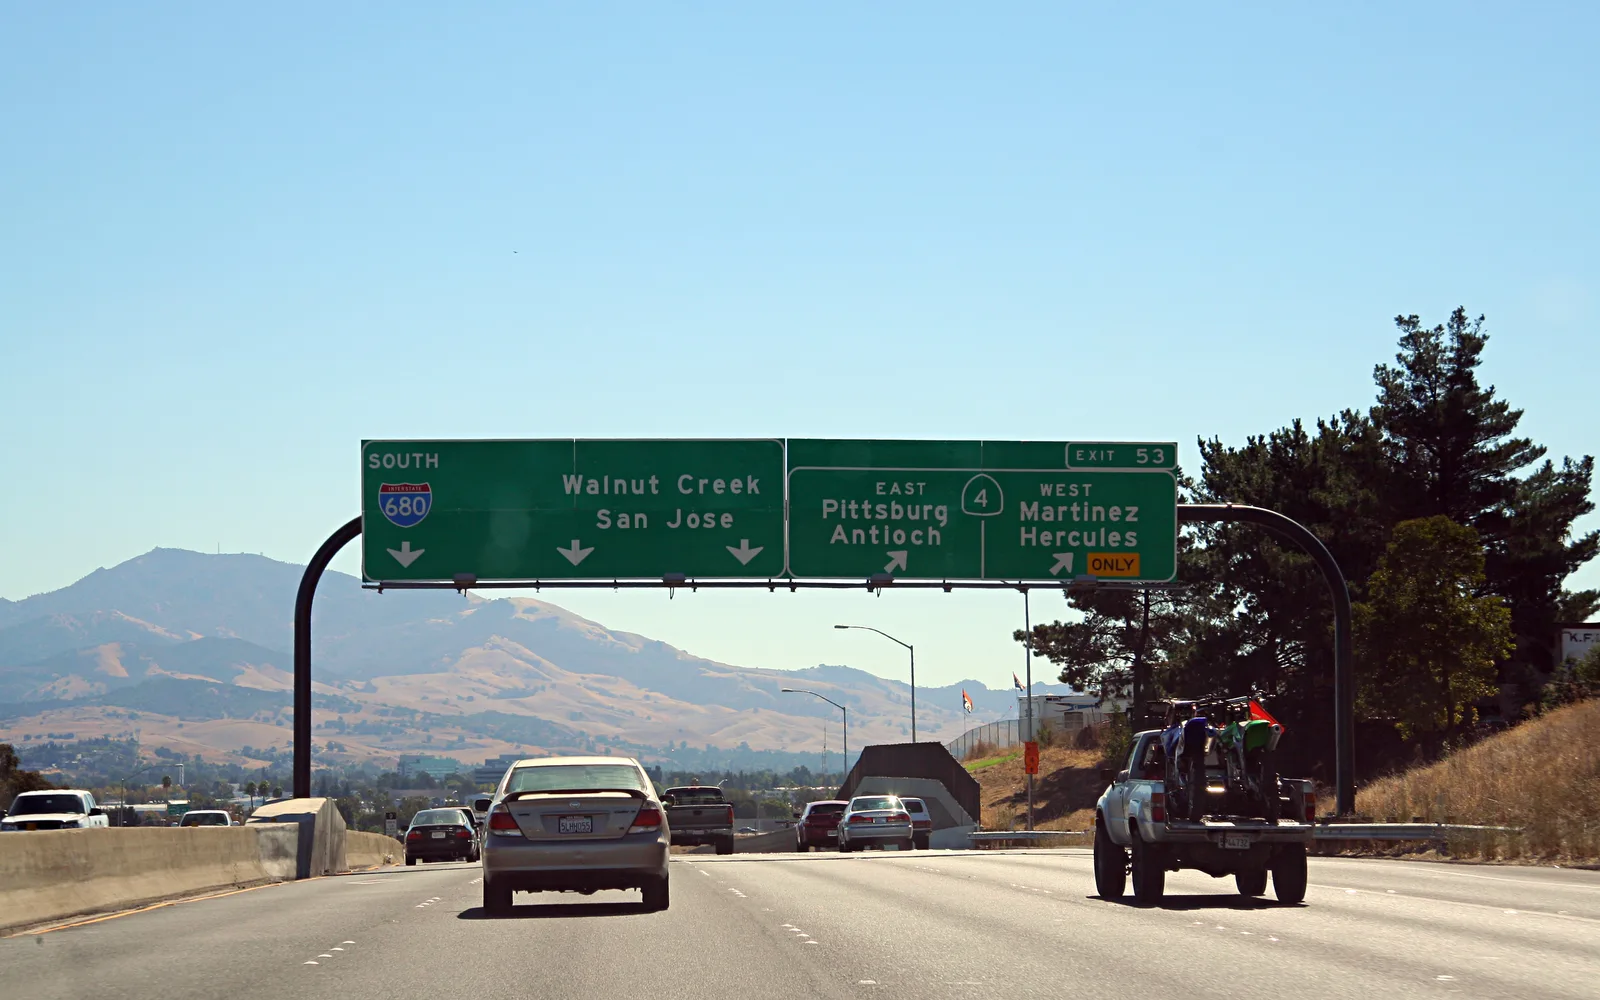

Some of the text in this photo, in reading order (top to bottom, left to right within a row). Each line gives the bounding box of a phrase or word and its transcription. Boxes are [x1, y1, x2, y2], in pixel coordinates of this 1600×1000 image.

[368, 453, 439, 469] SOUTH
[1076, 448, 1165, 464] EXIT 53
[562, 474, 761, 495] Walnut Creek
[876, 482, 927, 496] EAST
[1040, 483, 1093, 497] WEST
[385, 496, 427, 517] 680
[973, 488, 988, 507] 4
[596, 508, 734, 529] San Jose
[822, 499, 949, 527] Pittsburg
[1020, 501, 1139, 522] Martinez
[829, 524, 942, 546] Antioch
[1020, 526, 1138, 547] Hercules
[1091, 558, 1135, 572] ONLY
[561, 822, 590, 831] 5LHH055
